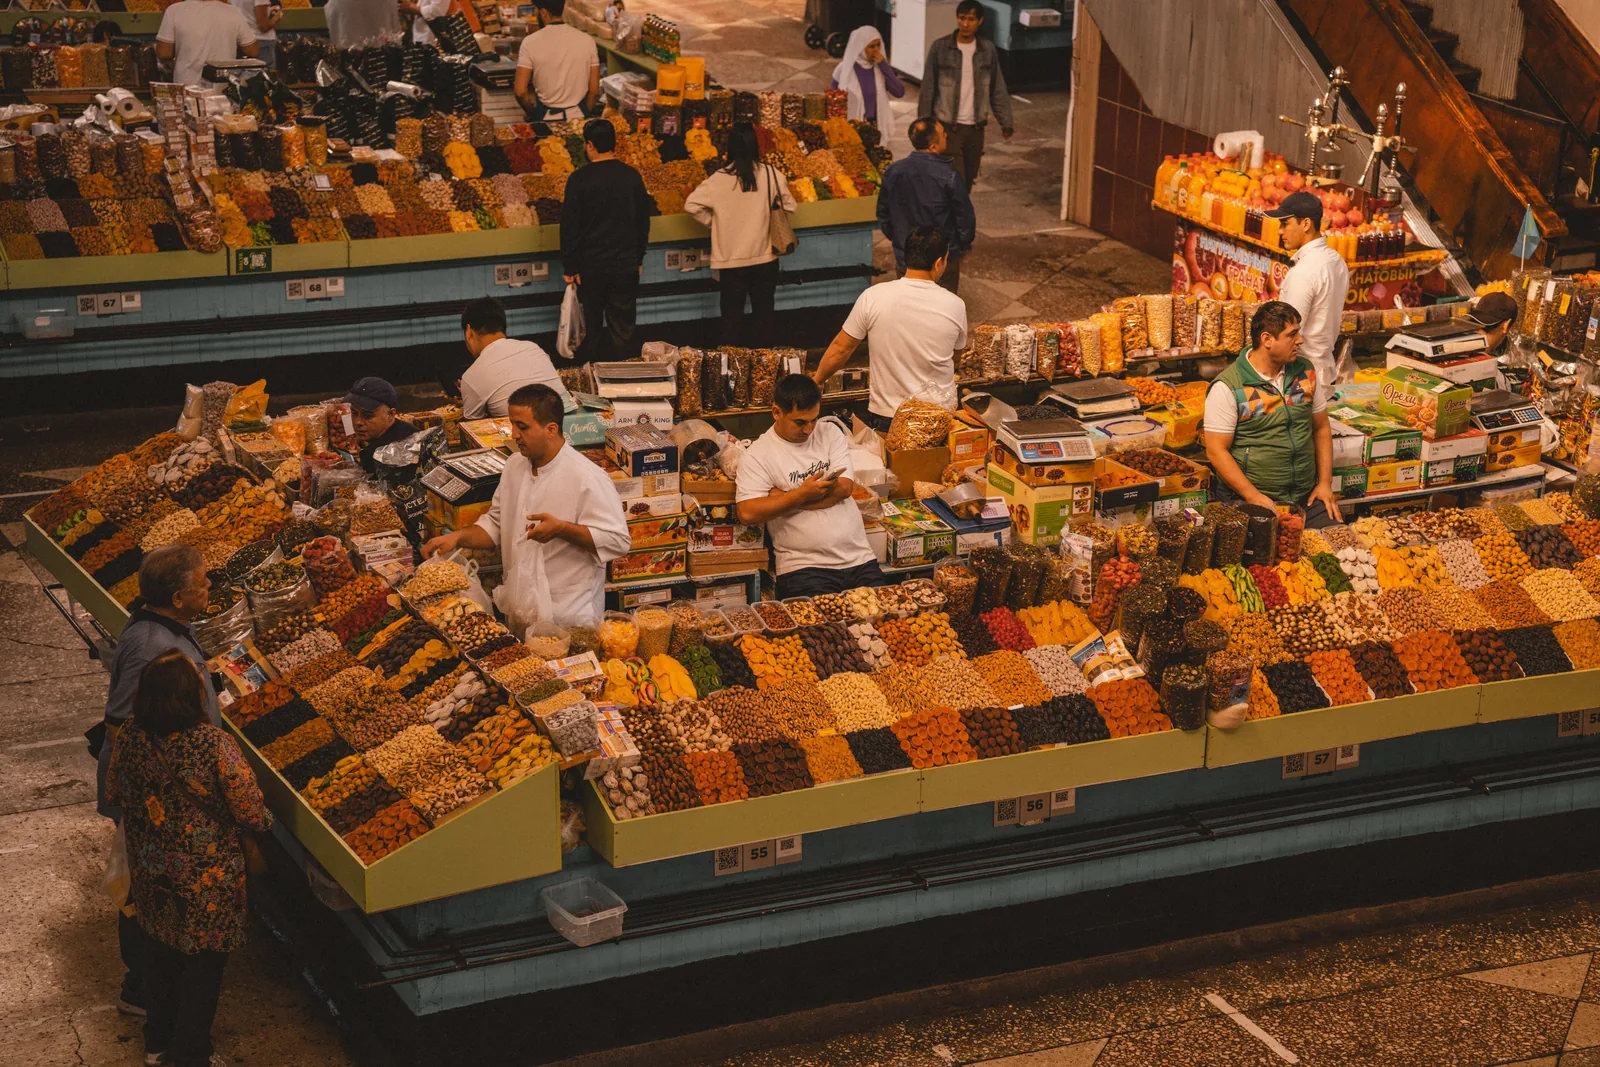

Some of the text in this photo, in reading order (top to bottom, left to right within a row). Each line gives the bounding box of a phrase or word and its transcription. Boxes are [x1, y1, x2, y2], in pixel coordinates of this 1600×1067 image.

[685, 255, 697, 263] 70
[1199, 231, 1290, 280] НАТУРАЛЬНЫЙ СО
[516, 269, 528, 277] 69
[309, 284, 322, 292] 68
[1345, 287, 1369, 304] ОК
[102, 299, 116, 308] 67
[1382, 382, 1417, 407] Орехи
[1444, 399, 1467, 412] Орехи
[1399, 437, 1419, 445] BLACK
[645, 454, 665, 463] PRUNES
[1343, 473, 1366, 481] BLACK
[928, 535, 953, 543] BLACK
[928, 540, 953, 548] RAISINS
[1314, 754, 1330, 765] 57
[1026, 799, 1044, 812] 56
[750, 847, 768, 860] 55
